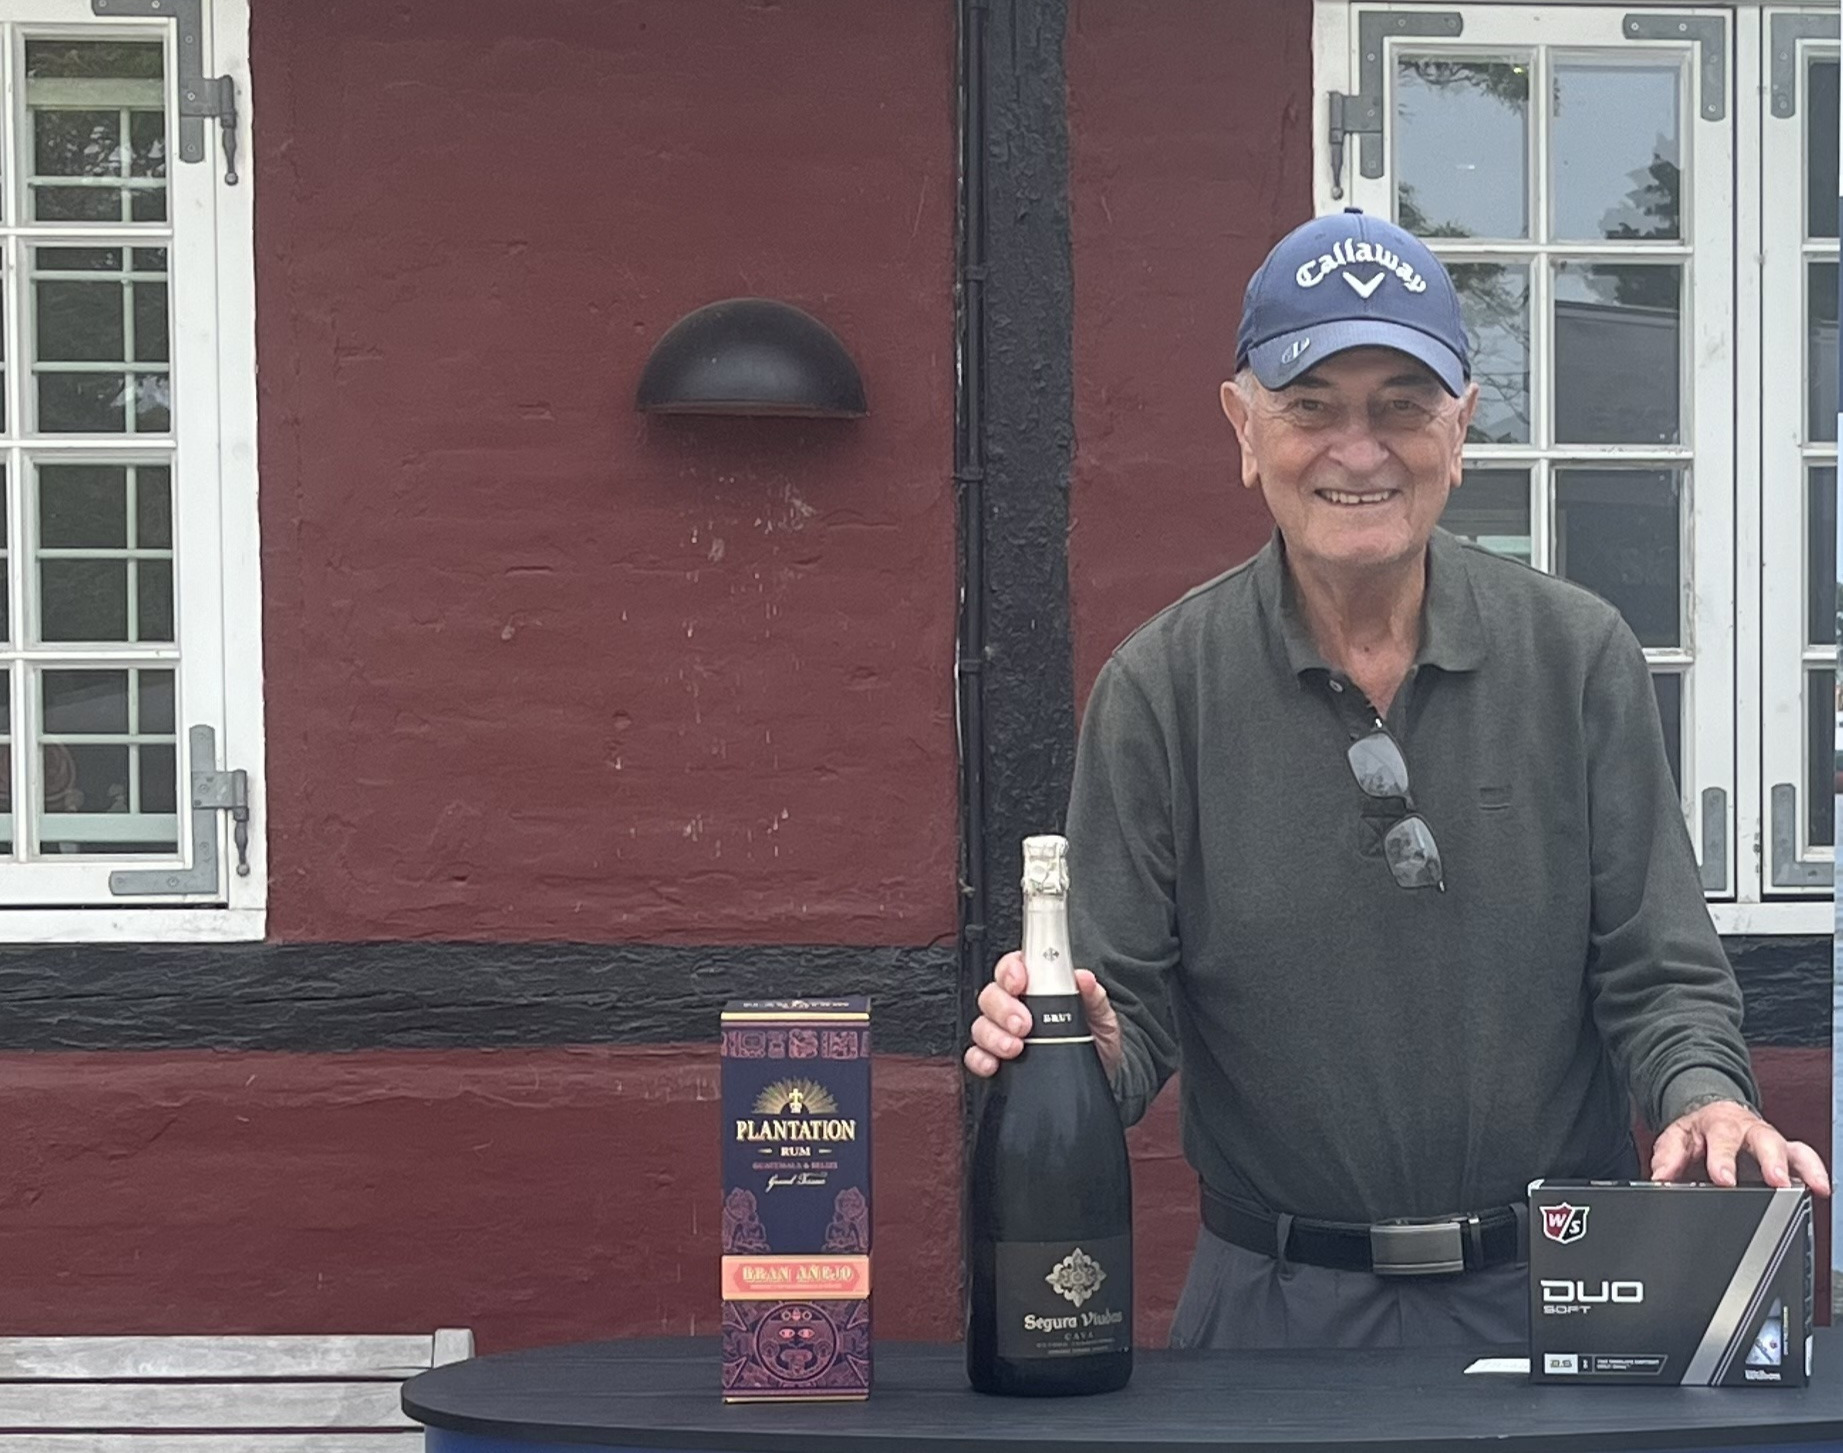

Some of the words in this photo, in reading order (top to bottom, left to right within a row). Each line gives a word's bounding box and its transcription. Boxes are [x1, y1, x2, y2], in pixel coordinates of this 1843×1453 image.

[1296, 238, 1427, 293] Callaway
[736, 1119, 856, 1141] PLANTATION
[780, 1146, 811, 1156] RUM
[1540, 1280, 1643, 1303] DUO
[1543, 1305, 1591, 1314] SOFT
[1024, 1314, 1077, 1332] Segura
[1064, 1331, 1094, 1341] CAVA
